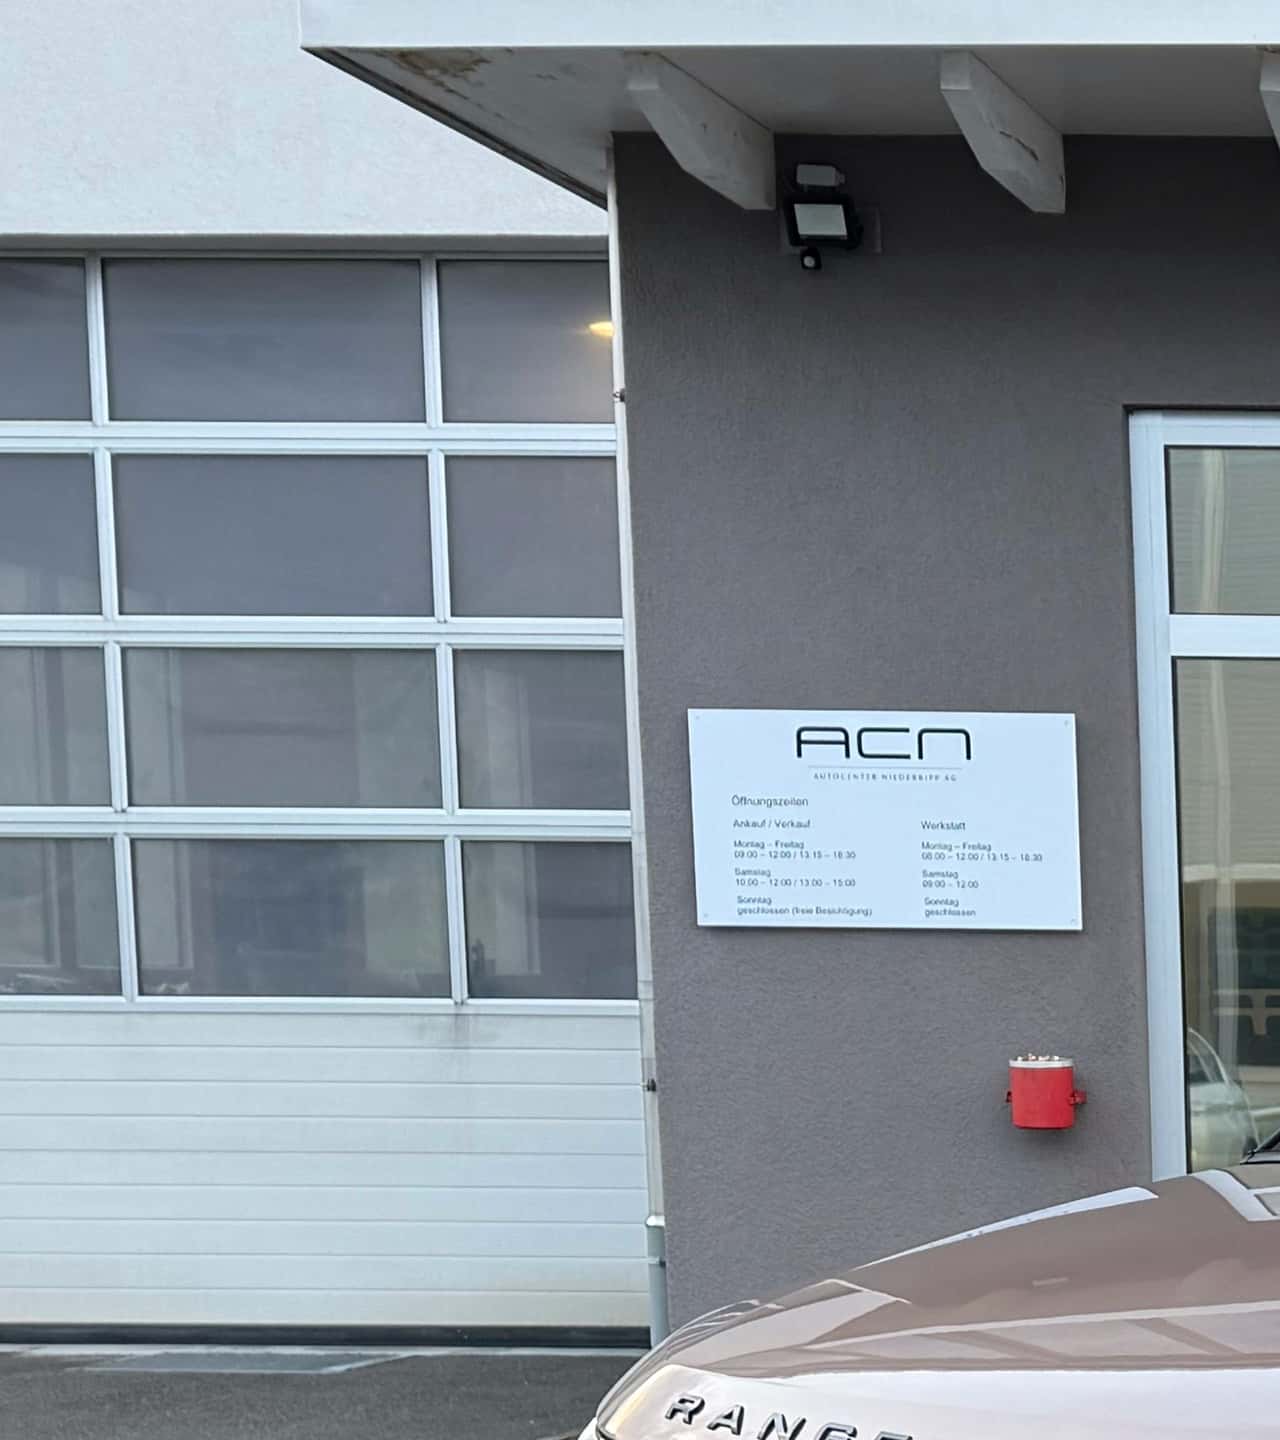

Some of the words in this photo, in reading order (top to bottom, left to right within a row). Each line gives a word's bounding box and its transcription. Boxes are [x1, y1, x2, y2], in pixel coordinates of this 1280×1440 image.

[813, 772, 877, 781] AUTOCENTER
[944, 773, 957, 782] AG
[731, 794, 809, 808] Öffnungszeiten
[733, 819, 767, 828] Ankauf
[774, 819, 811, 828] Verkauf
[920, 820, 966, 831] Werkstatt
[733, 840, 765, 849] Montag
[775, 840, 805, 850] Freitag
[921, 841, 953, 852] Montag
[962, 842, 992, 852] Freitag
[734, 868, 772, 877] Samstag
[921, 869, 959, 880] Samstag
[736, 895, 772, 905] Sonntag
[924, 896, 960, 907] Sonntag
